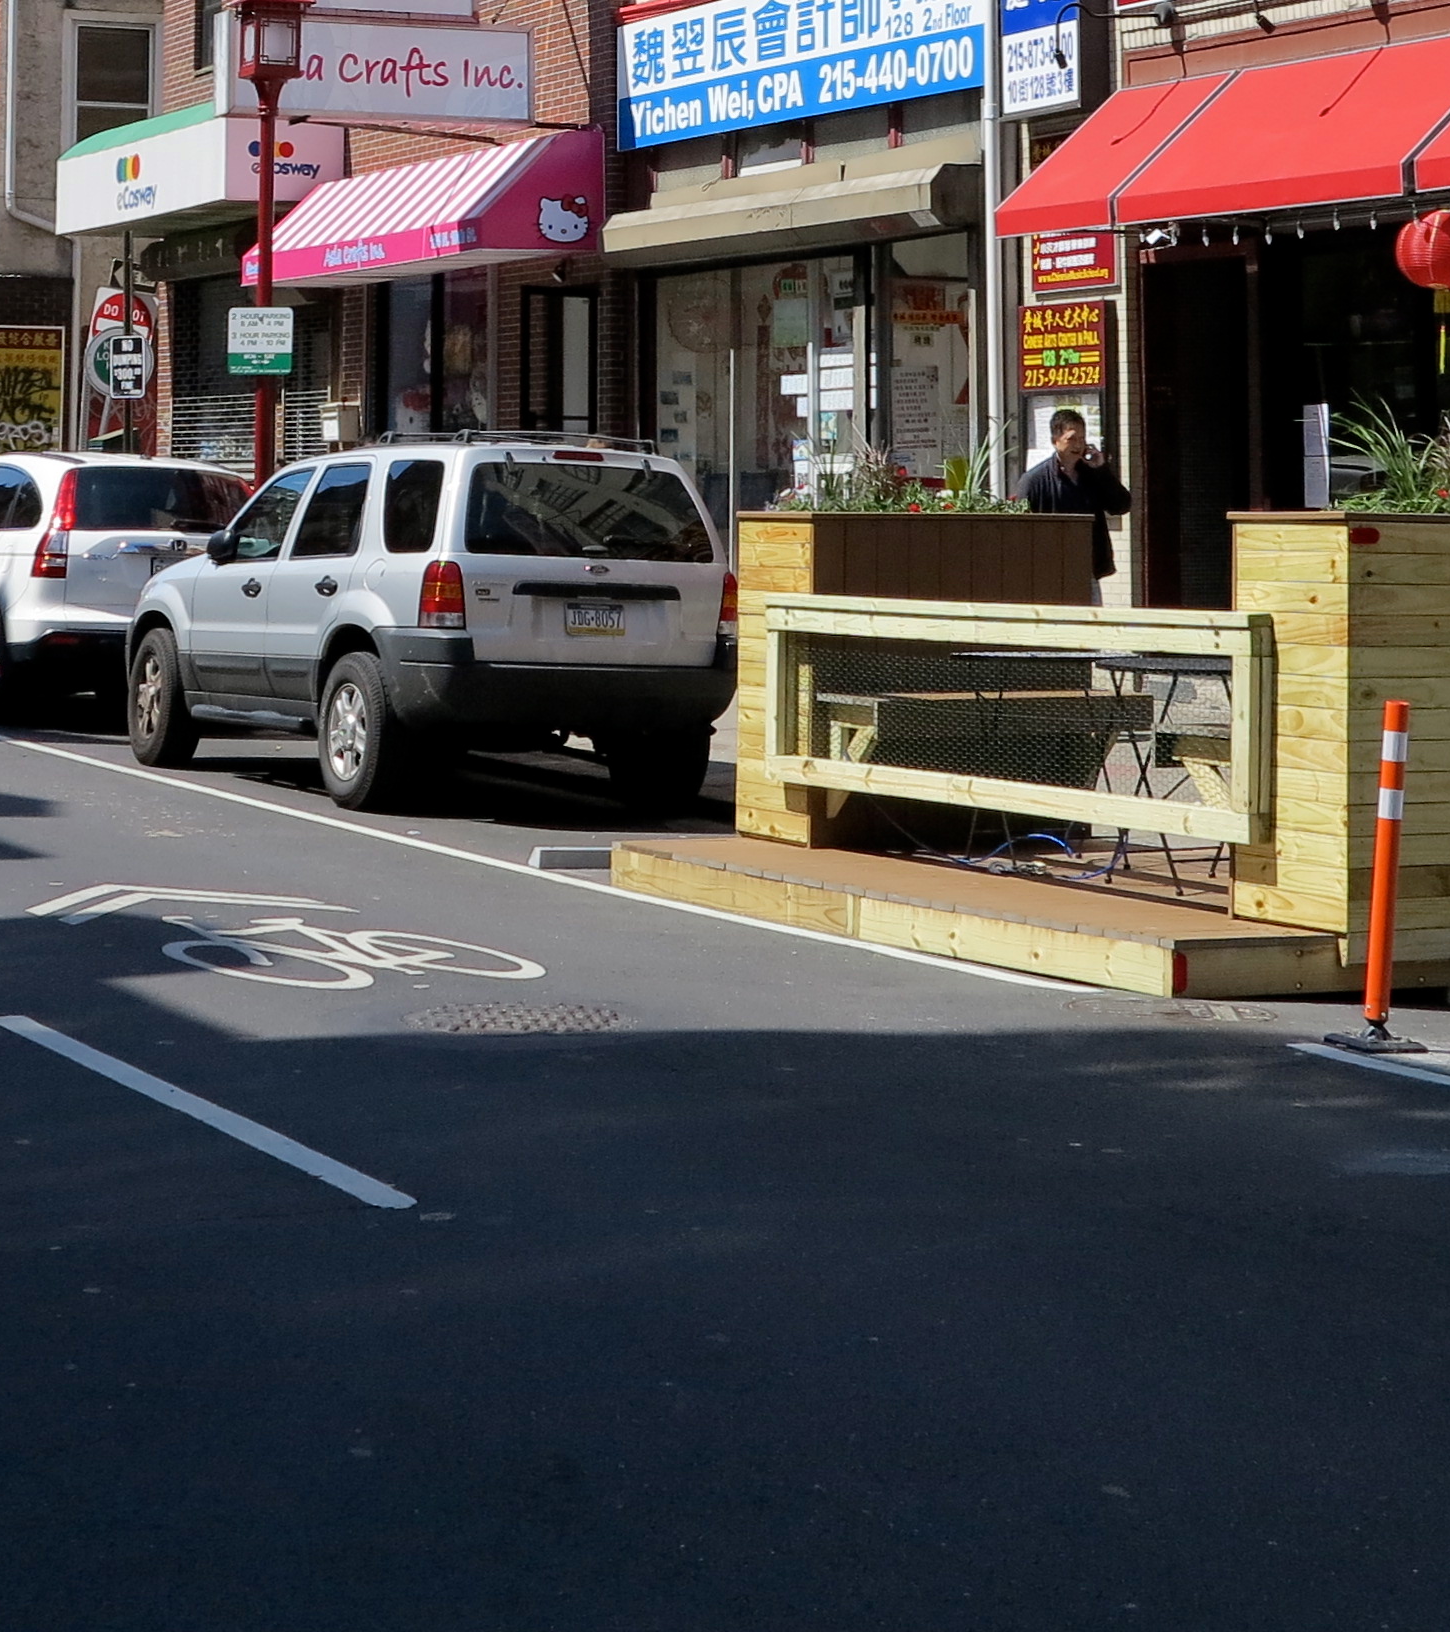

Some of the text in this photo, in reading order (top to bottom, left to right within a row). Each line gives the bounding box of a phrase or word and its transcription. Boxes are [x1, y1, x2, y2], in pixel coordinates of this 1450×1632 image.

[885, 2, 973, 40] 128 2nd Floor
[1007, 31, 1074, 73] 215-873-800
[338, 47, 450, 98] Crafts
[462, 58, 525, 90] Inc.
[817, 36, 974, 105] 215-440-0700
[629, 70, 804, 139] Yichen Wei, CPA
[250, 161, 321, 180] eosway
[103, 303, 119, 317] DO
[261, 312, 291, 320] PARKING
[121, 339, 134, 352] NO
[113, 353, 142, 366] DUMPING
[1023, 366, 1100, 387] 215-941-2524
